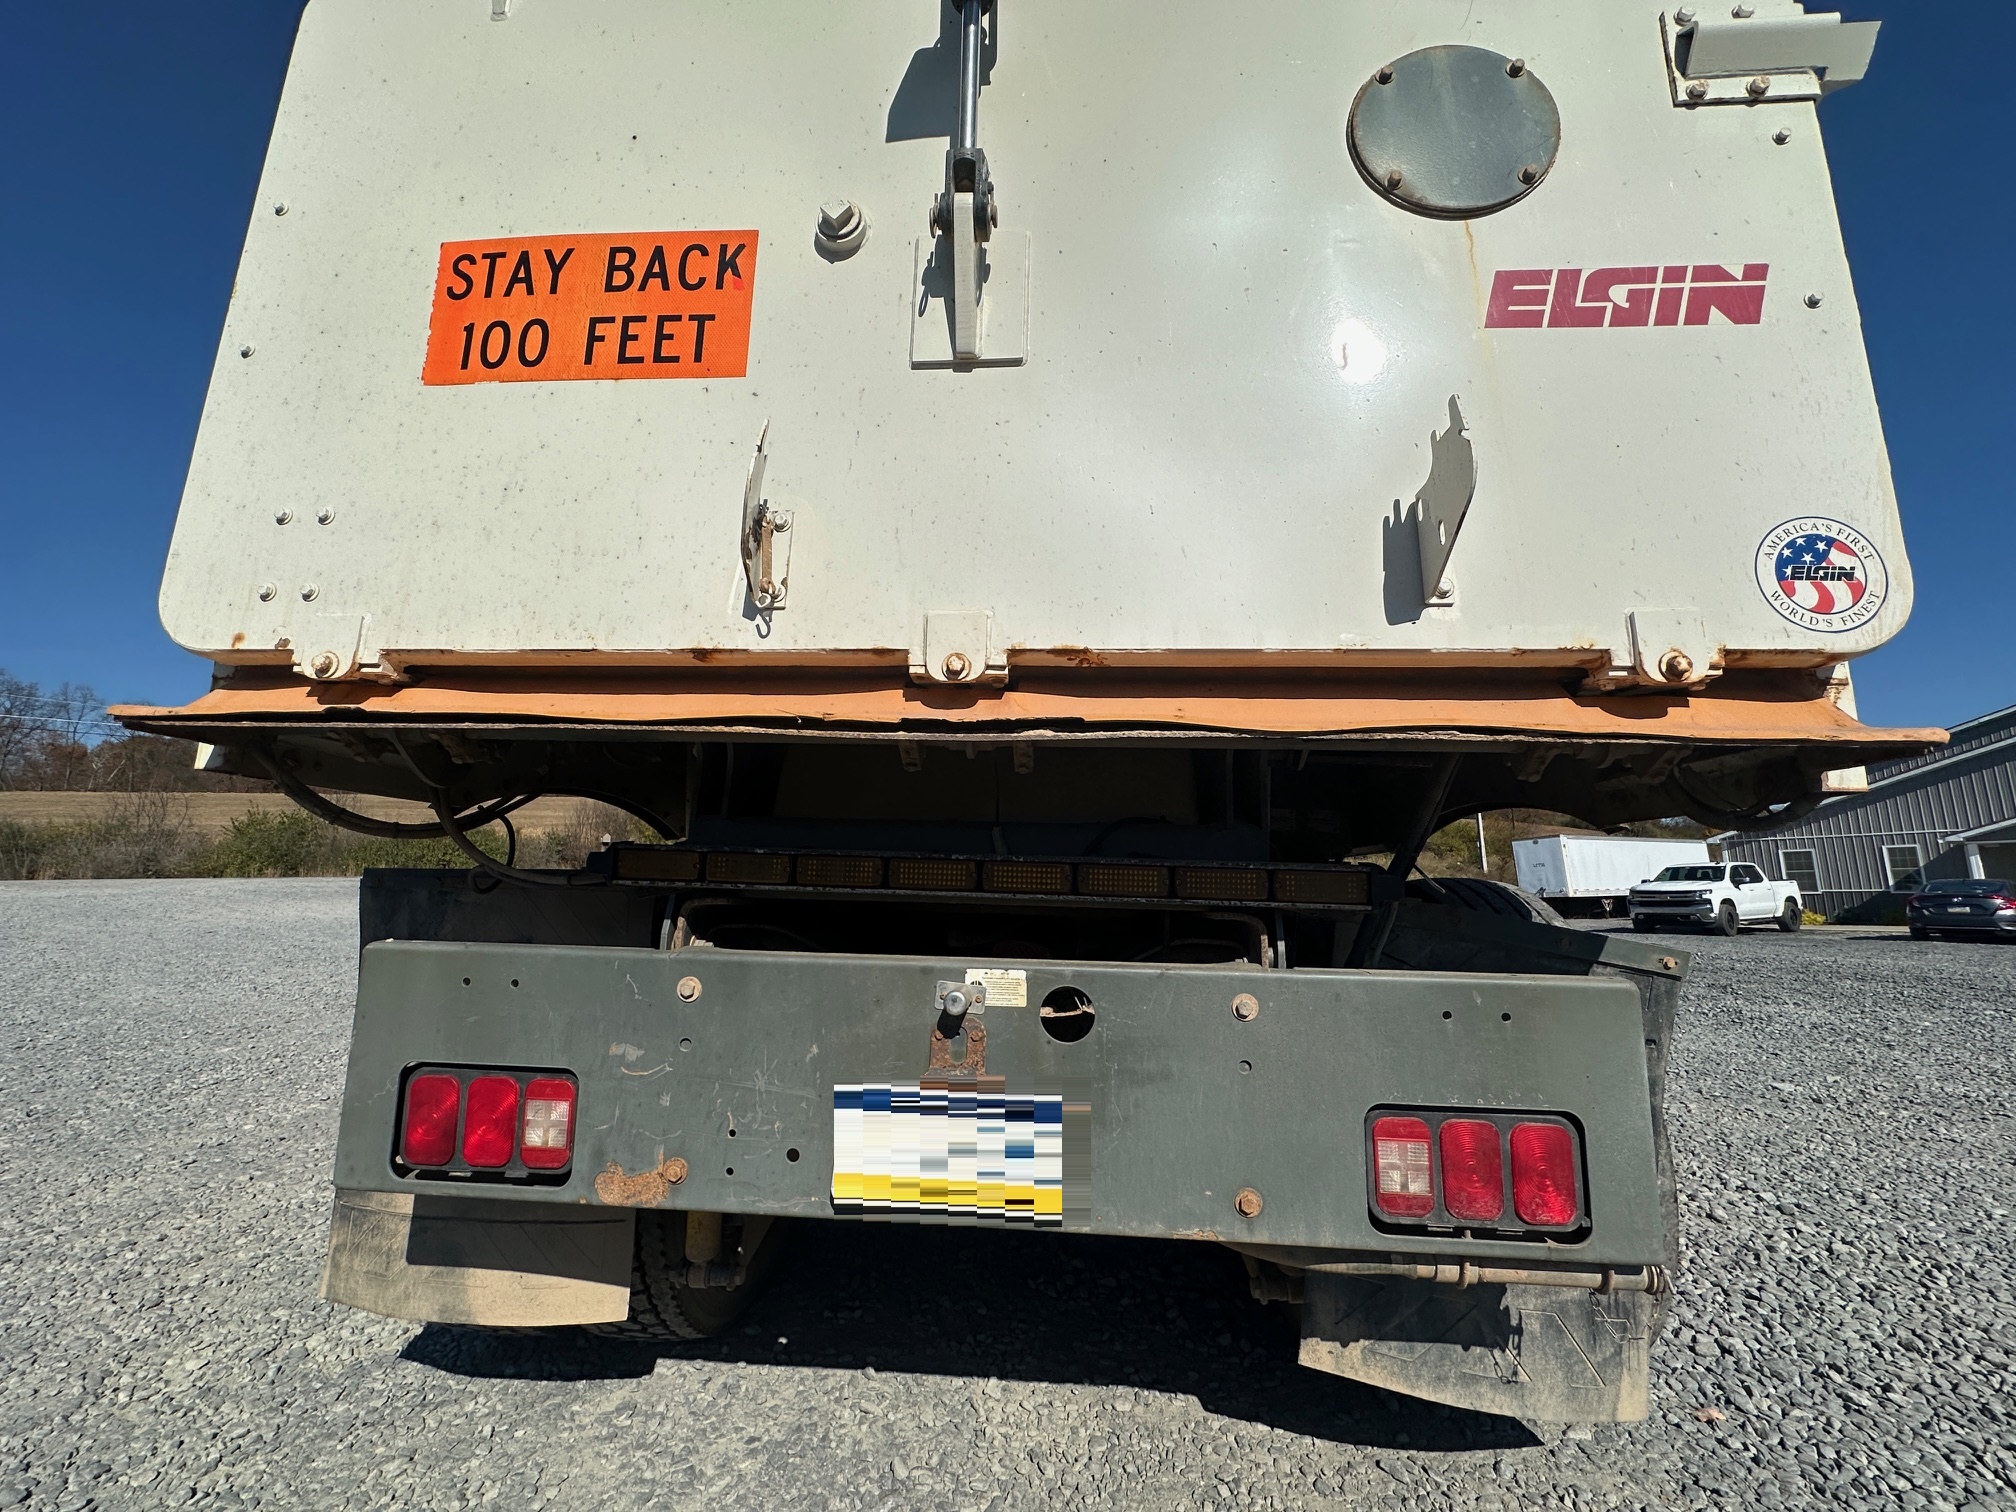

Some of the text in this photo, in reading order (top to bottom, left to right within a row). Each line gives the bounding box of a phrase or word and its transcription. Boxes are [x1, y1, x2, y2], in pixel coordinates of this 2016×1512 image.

[447, 243, 746, 300] STAY BACK
[1484, 263, 1769, 328] ELGIN
[460, 314, 715, 370] 100 FEET
[1764, 523, 1875, 561] AMERICA'S FIRST
[1789, 565, 1856, 582] ELGIN
[1770, 590, 1879, 627] WORLD'S FINEST
